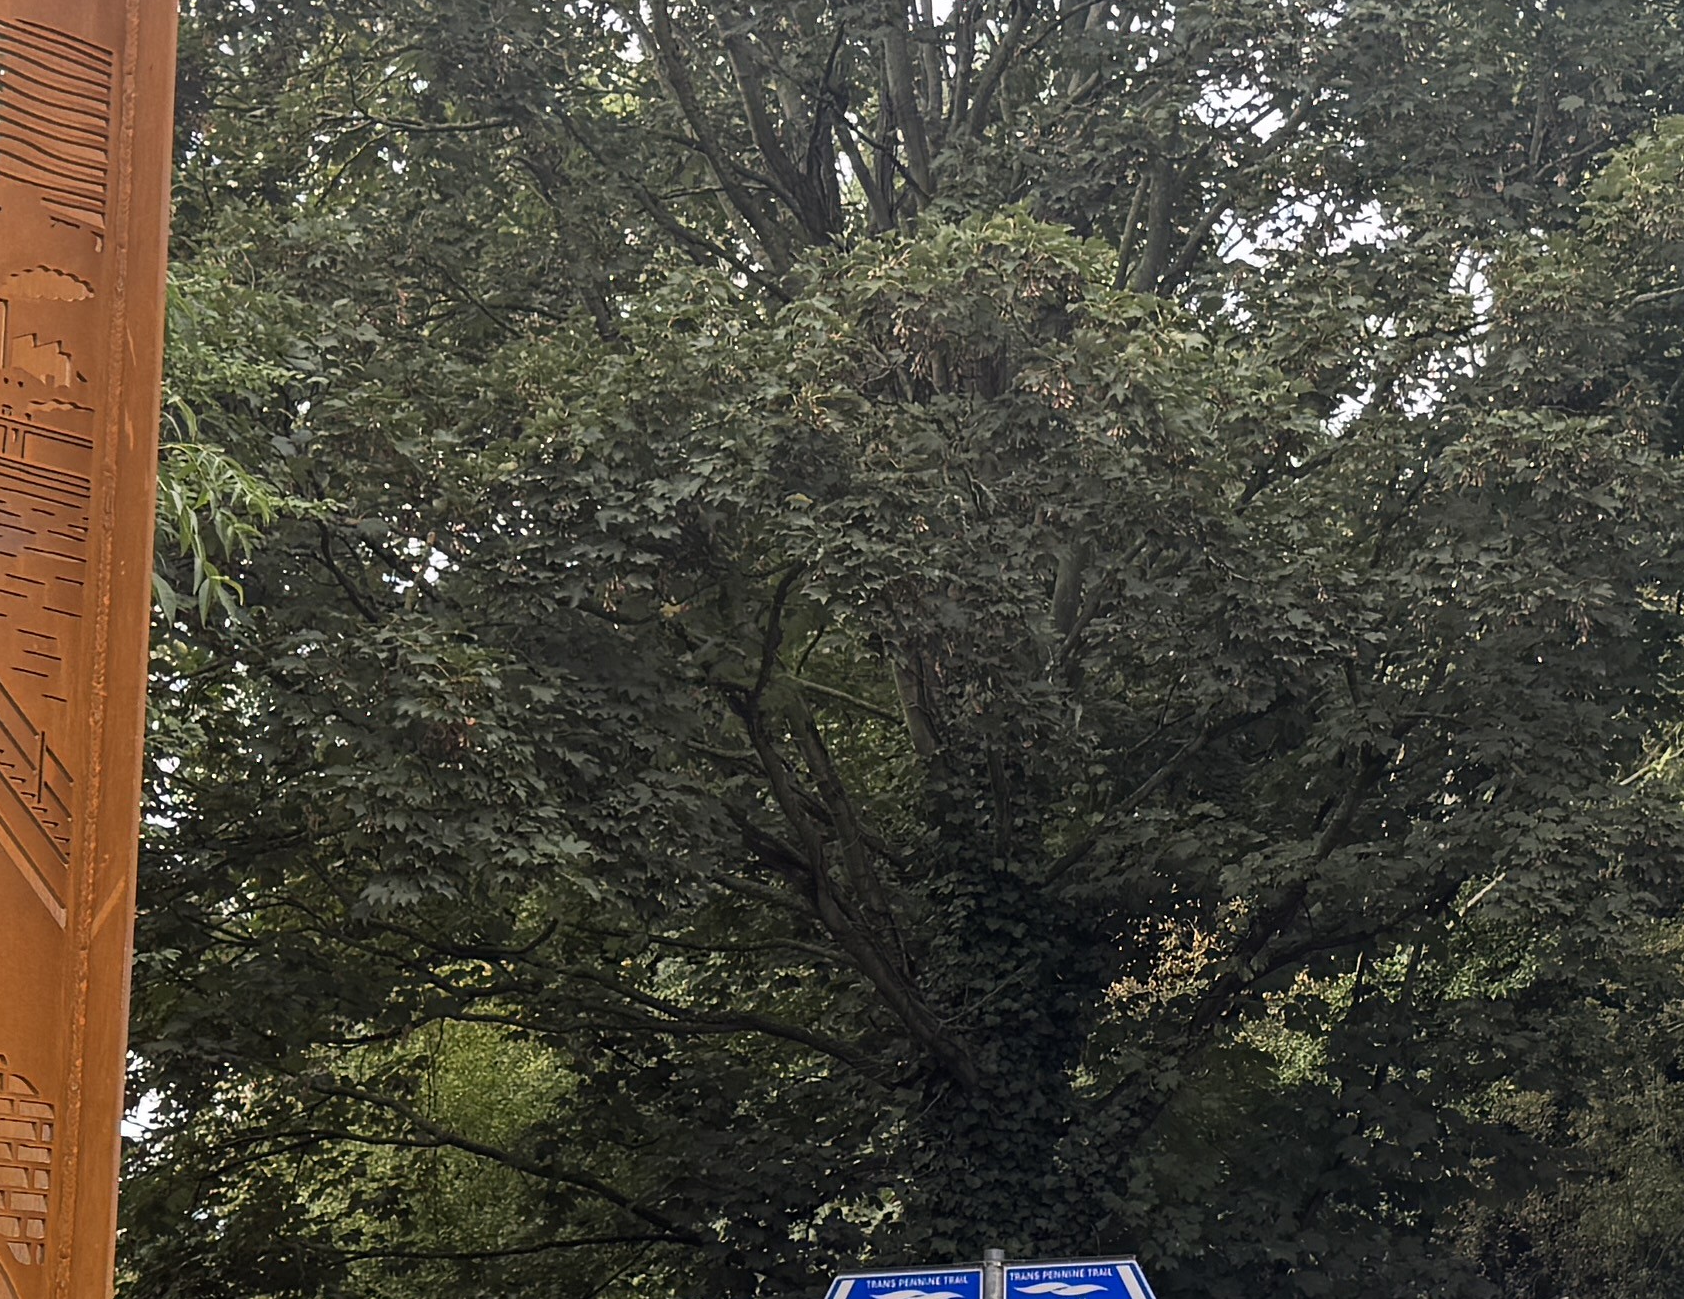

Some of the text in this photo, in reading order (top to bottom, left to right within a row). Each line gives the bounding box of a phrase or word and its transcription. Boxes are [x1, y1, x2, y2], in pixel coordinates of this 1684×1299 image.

[1009, 1267, 1114, 1281] TRANS PENNINE TRAIL
[866, 1274, 969, 1289] TRANS PENNINE TRAIL
